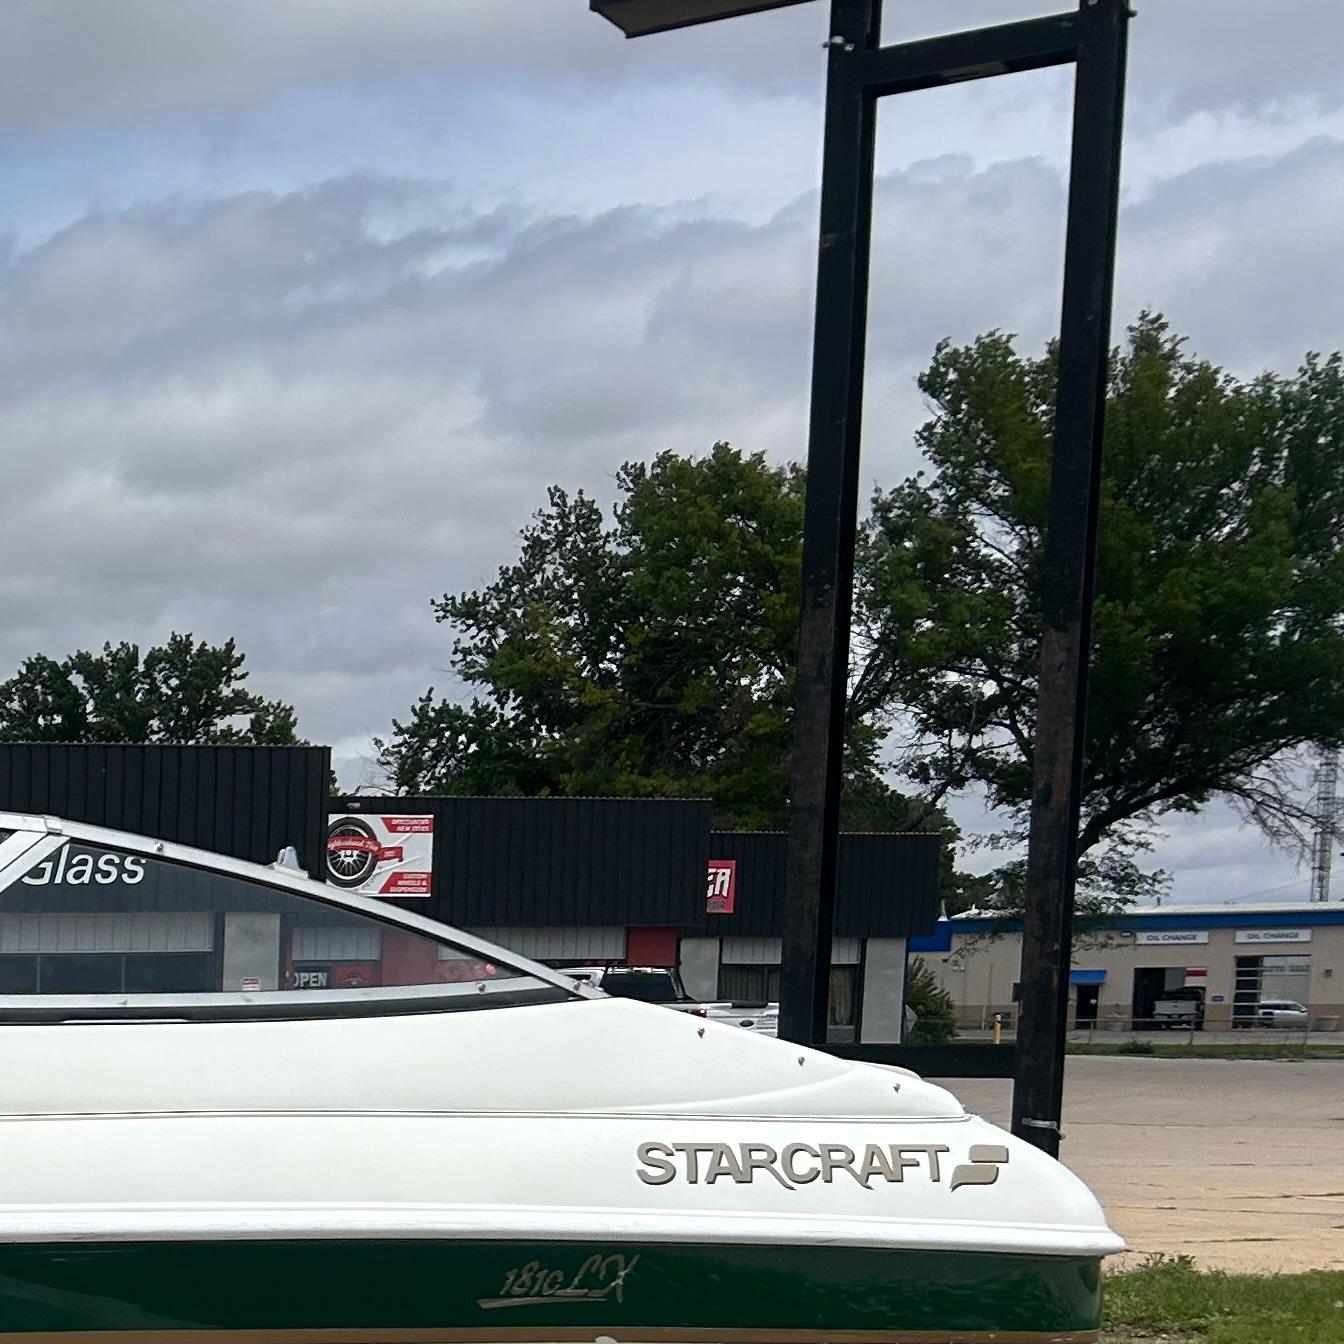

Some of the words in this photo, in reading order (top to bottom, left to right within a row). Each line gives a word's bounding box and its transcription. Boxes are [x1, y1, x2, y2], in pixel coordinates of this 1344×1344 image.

[1162, 933, 1198, 942] CHANGE
[1263, 931, 1299, 940] CHANGE
[636, 1141, 950, 1191] STARCRAFT
